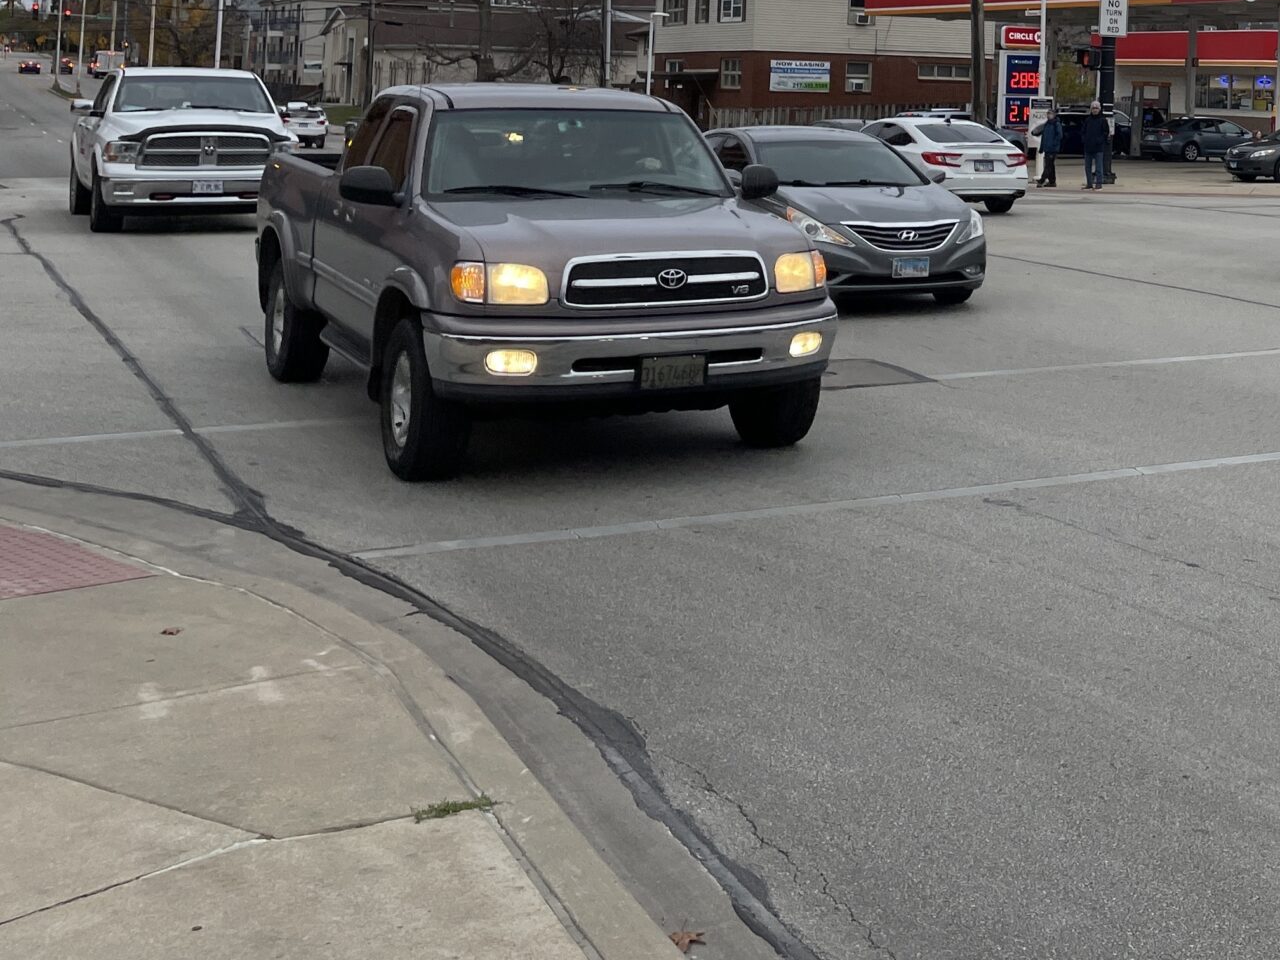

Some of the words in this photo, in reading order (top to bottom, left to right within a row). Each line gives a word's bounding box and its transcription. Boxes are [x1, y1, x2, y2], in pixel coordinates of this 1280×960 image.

[1107, 0, 1121, 8] NO
[1105, 9, 1123, 17] TURN
[1107, 26, 1120, 34] RED
[1008, 31, 1034, 41] CIRCLE
